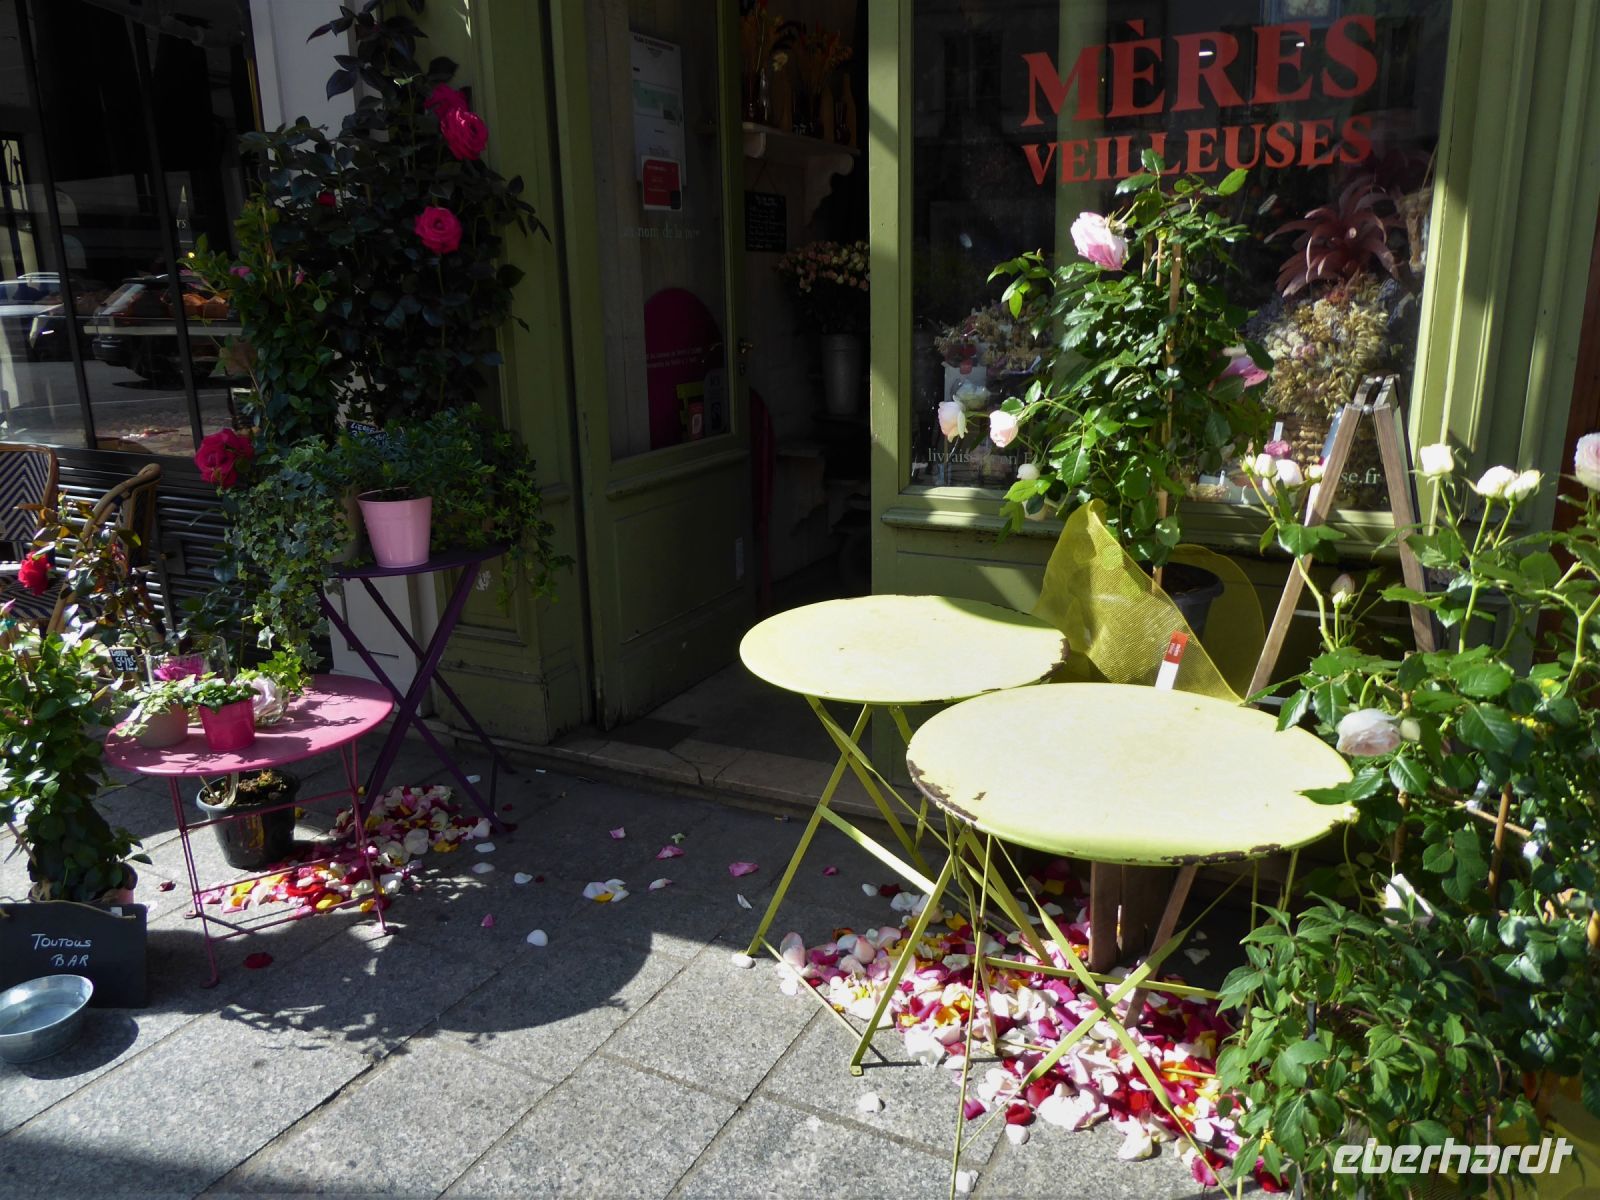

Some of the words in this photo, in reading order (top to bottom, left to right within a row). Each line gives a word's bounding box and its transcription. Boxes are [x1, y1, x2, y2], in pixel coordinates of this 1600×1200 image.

[1020, 14, 1377, 127] MÈRES
[1021, 114, 1373, 185] VEILLEUSES
[51, 953, 89, 967] BAR
